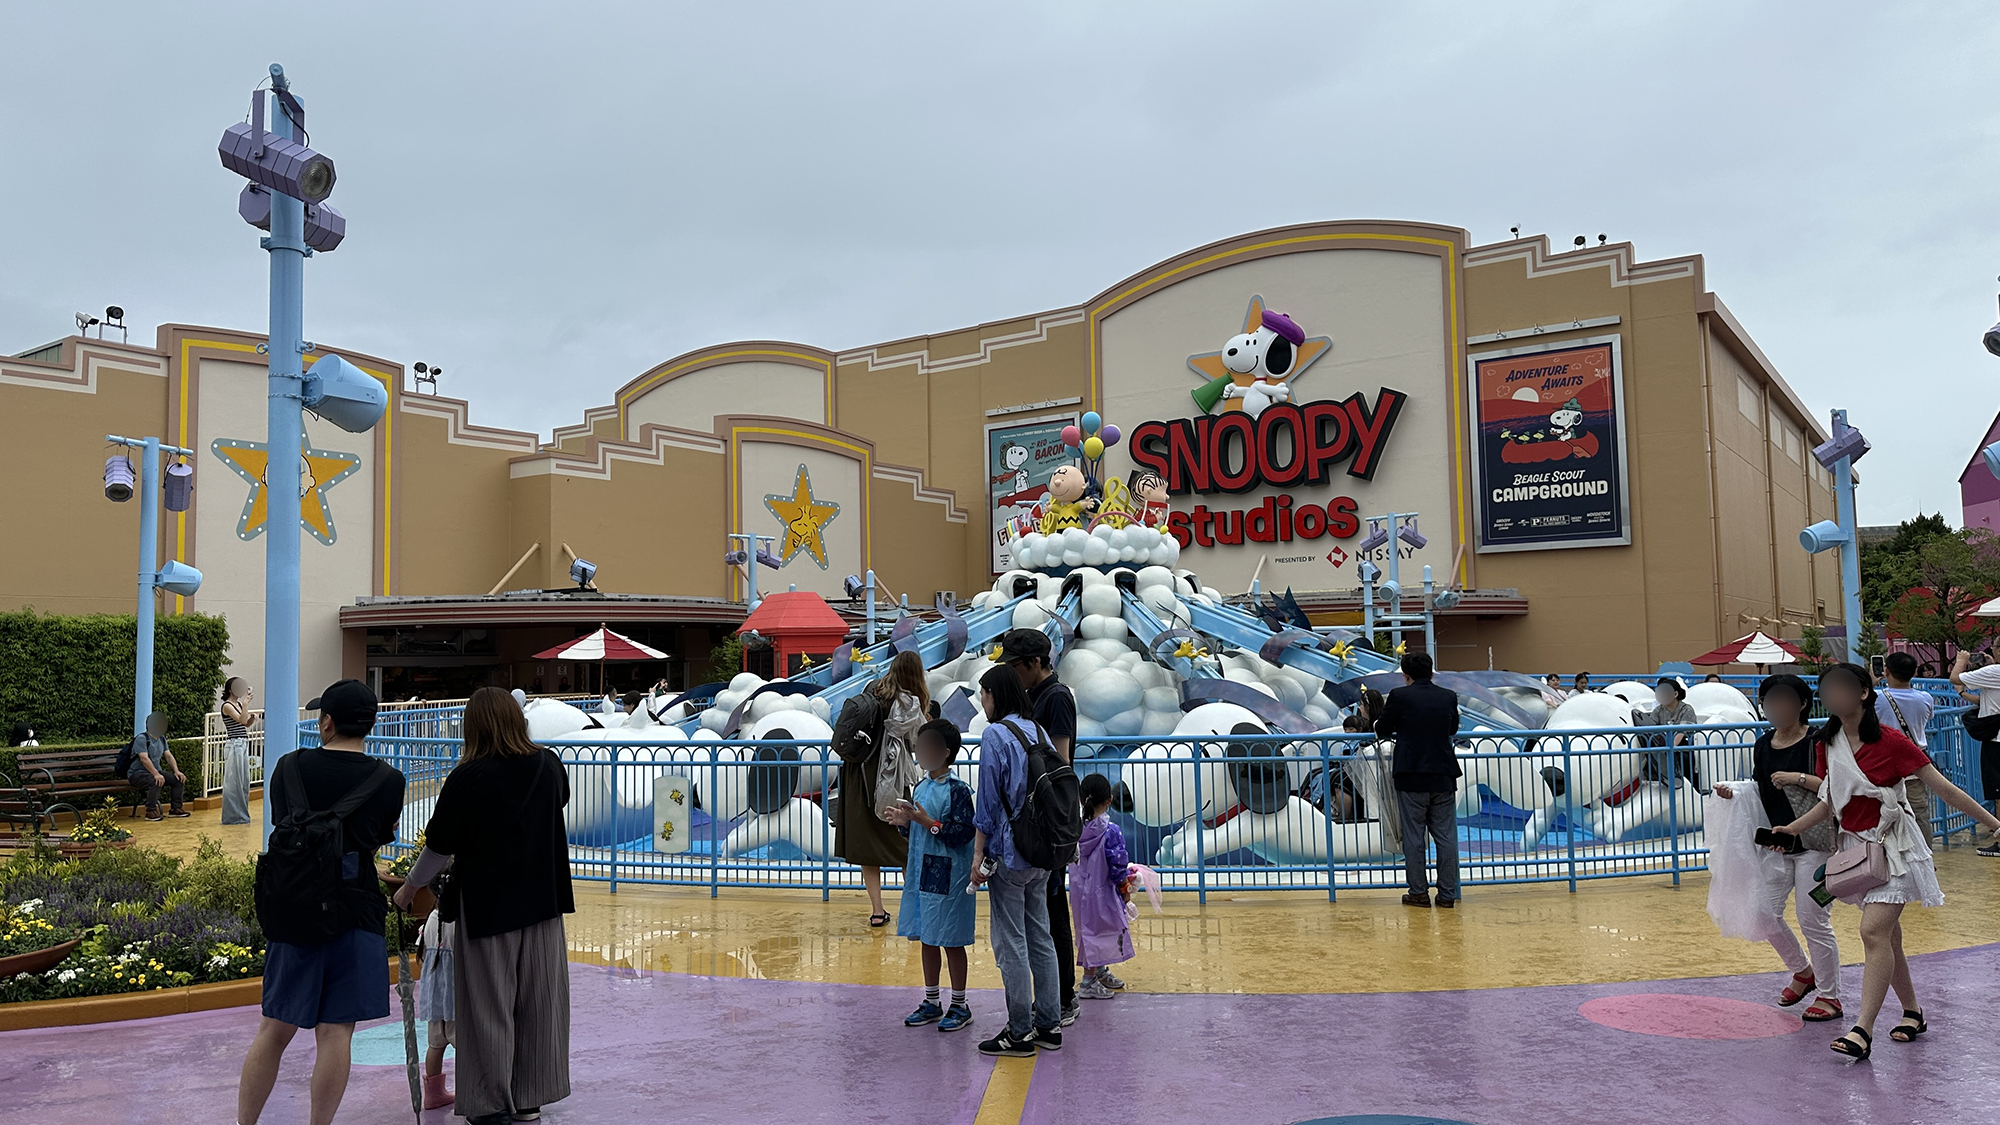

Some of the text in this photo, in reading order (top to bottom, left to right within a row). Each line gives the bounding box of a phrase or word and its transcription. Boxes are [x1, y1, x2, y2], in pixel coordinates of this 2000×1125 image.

[1505, 364, 1569, 382] ADVENTURE
[1541, 376, 1583, 391] AWAITS
[1036, 439, 1047, 447] RED
[1130, 388, 1403, 493] SNOOPY
[1035, 443, 1065, 460] BARON
[1513, 469, 1585, 485] BEAGLE SCOUT
[1493, 480, 1608, 503] CAMPGROUND
[998, 1038, 1012, 1050] N
